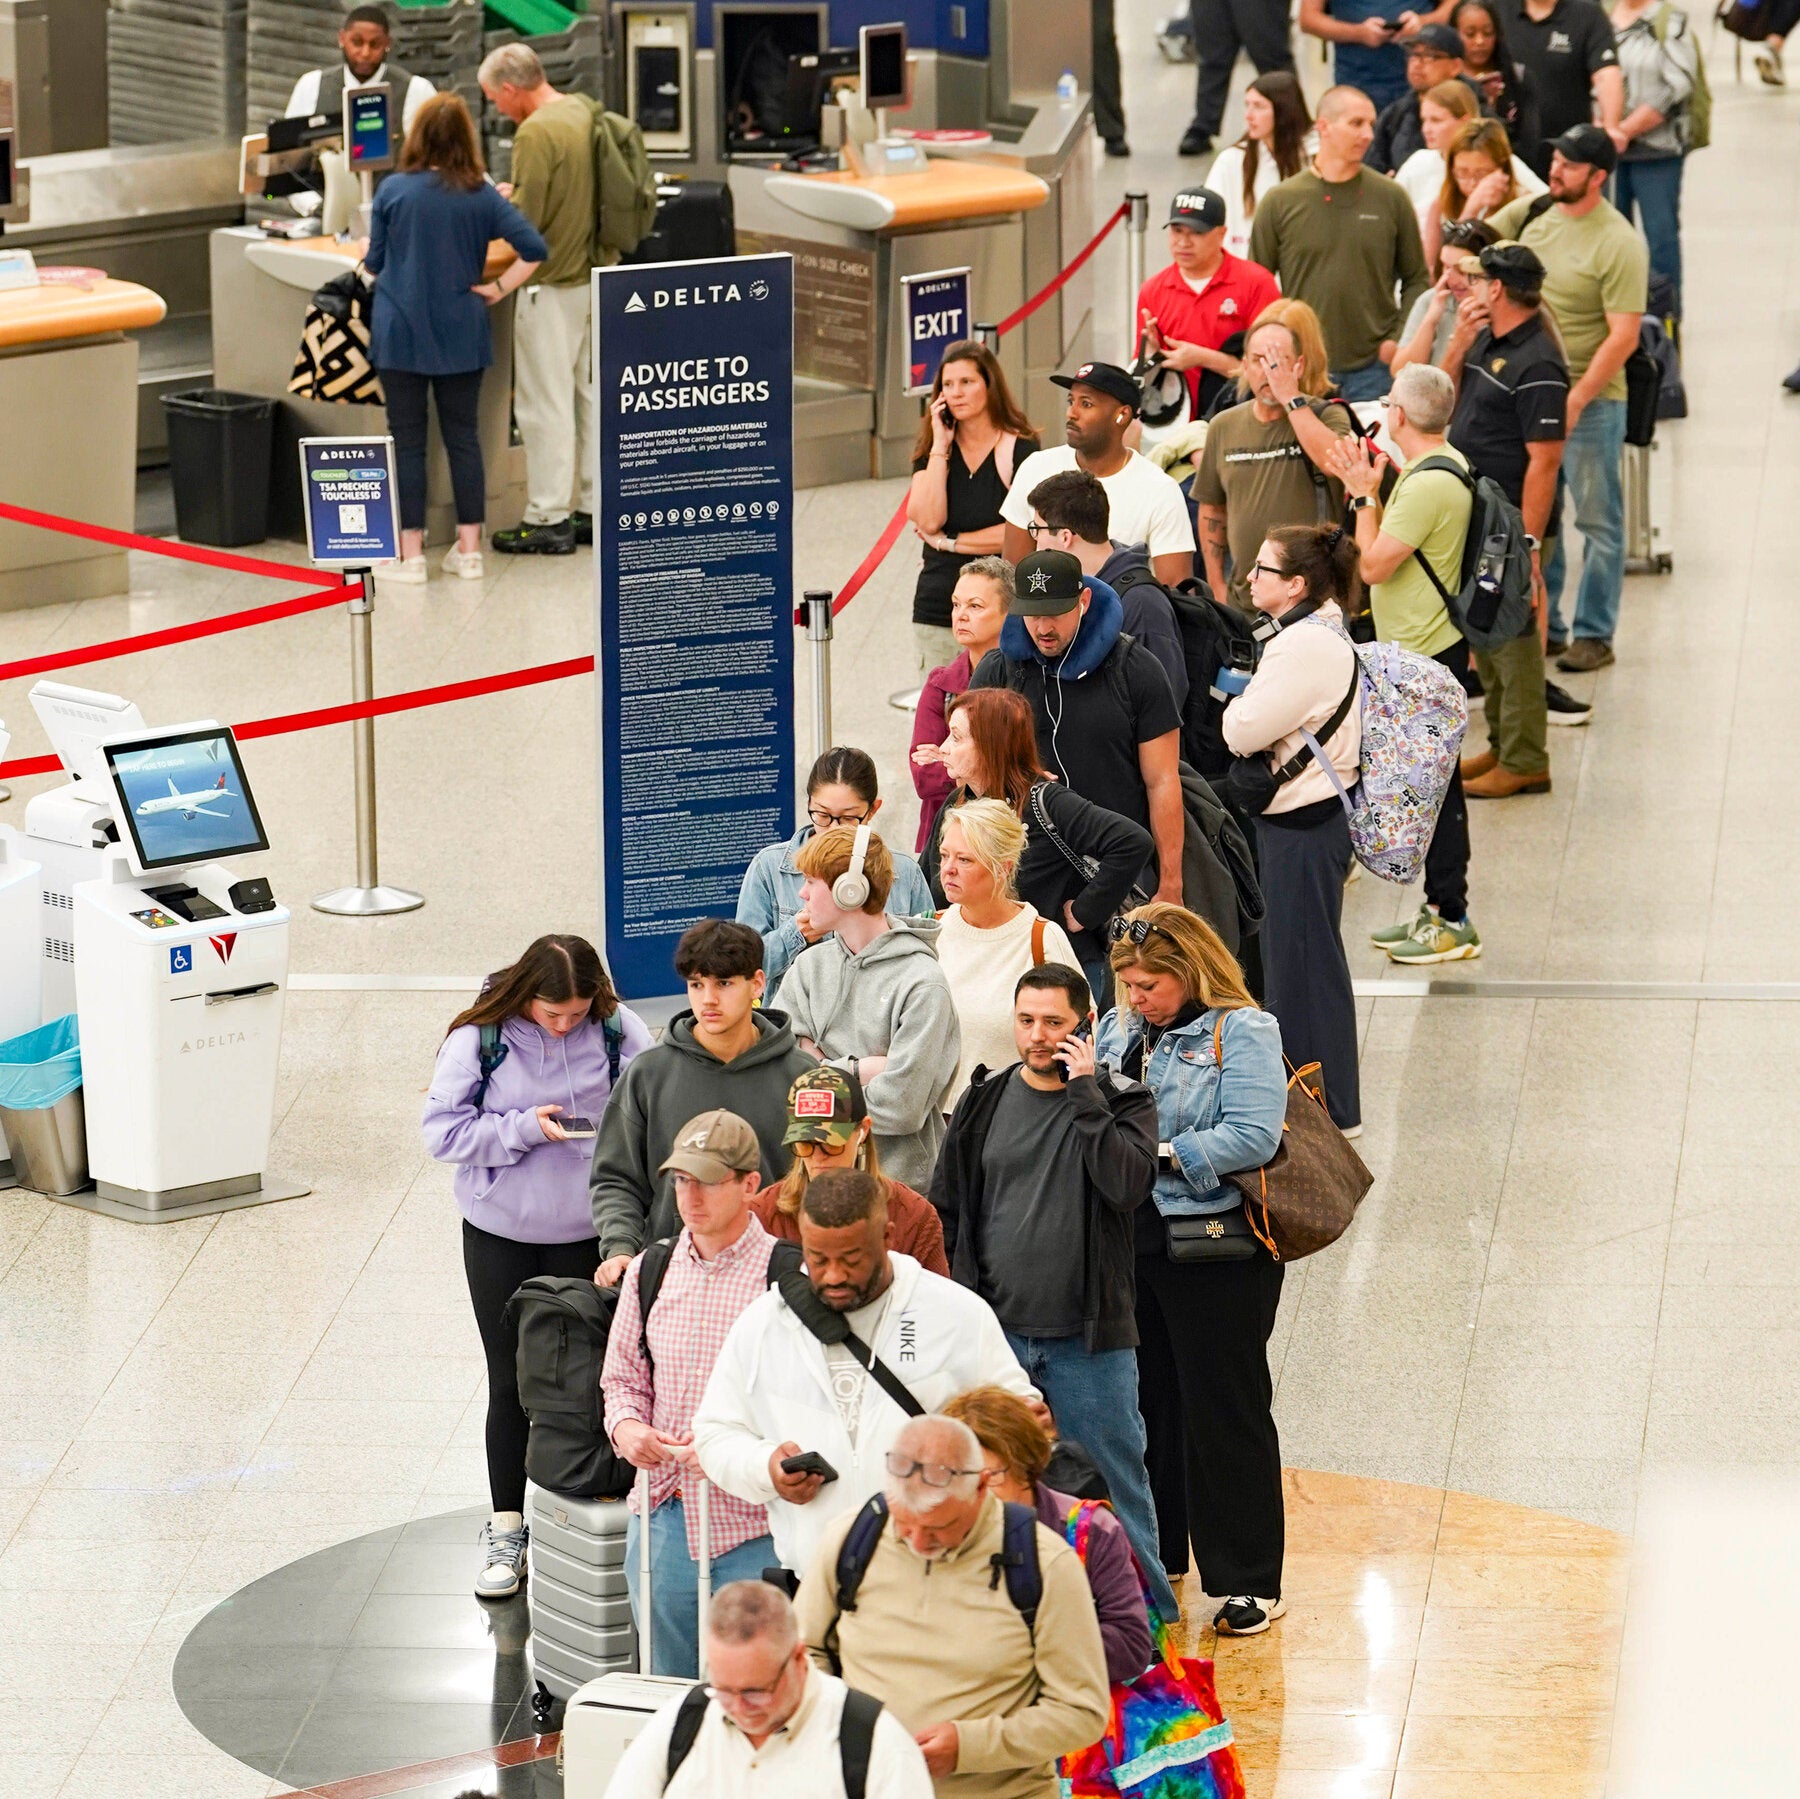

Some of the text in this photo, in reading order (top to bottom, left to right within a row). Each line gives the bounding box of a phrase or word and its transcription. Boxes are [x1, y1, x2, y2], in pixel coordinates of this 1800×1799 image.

[1175, 194, 1206, 211] THE
[840, 261, 869, 277] CHECK
[654, 284, 742, 308] DELTA
[925, 283, 951, 293] DELTA
[914, 309, 962, 341] EXIT
[619, 355, 749, 387] ADVICE TO
[620, 380, 770, 414] PASSENGERS
[619, 430, 677, 441] TRANSPORTATION
[688, 425, 729, 435] HAZARDOUS
[731, 422, 767, 431] MATERIALS
[619, 441, 642, 450] Federal
[656, 438, 678, 446] forbids
[691, 434, 717, 444] carriage
[727, 431, 760, 440] hazardous
[331, 450, 365, 459] DELTA
[619, 450, 649, 459] materials
[650, 447, 672, 456] aboard
[673, 445, 698, 455] aircraft,
[706, 443, 721, 452] your
[723, 441, 748, 451] luggage
[1225, 448, 1286, 462] UNDER ARMOUR
[619, 458, 658, 469] your person.
[319, 482, 381, 492] TSA PRECHECK
[321, 491, 381, 501] TOUCHLESS ID
[142, 762, 158, 771] HERE
[157, 760, 166, 769] TO
[167, 758, 184, 767] BEGIN
[196, 1032, 246, 1050] DELTA
[900, 1320, 916, 1362] NIKE
